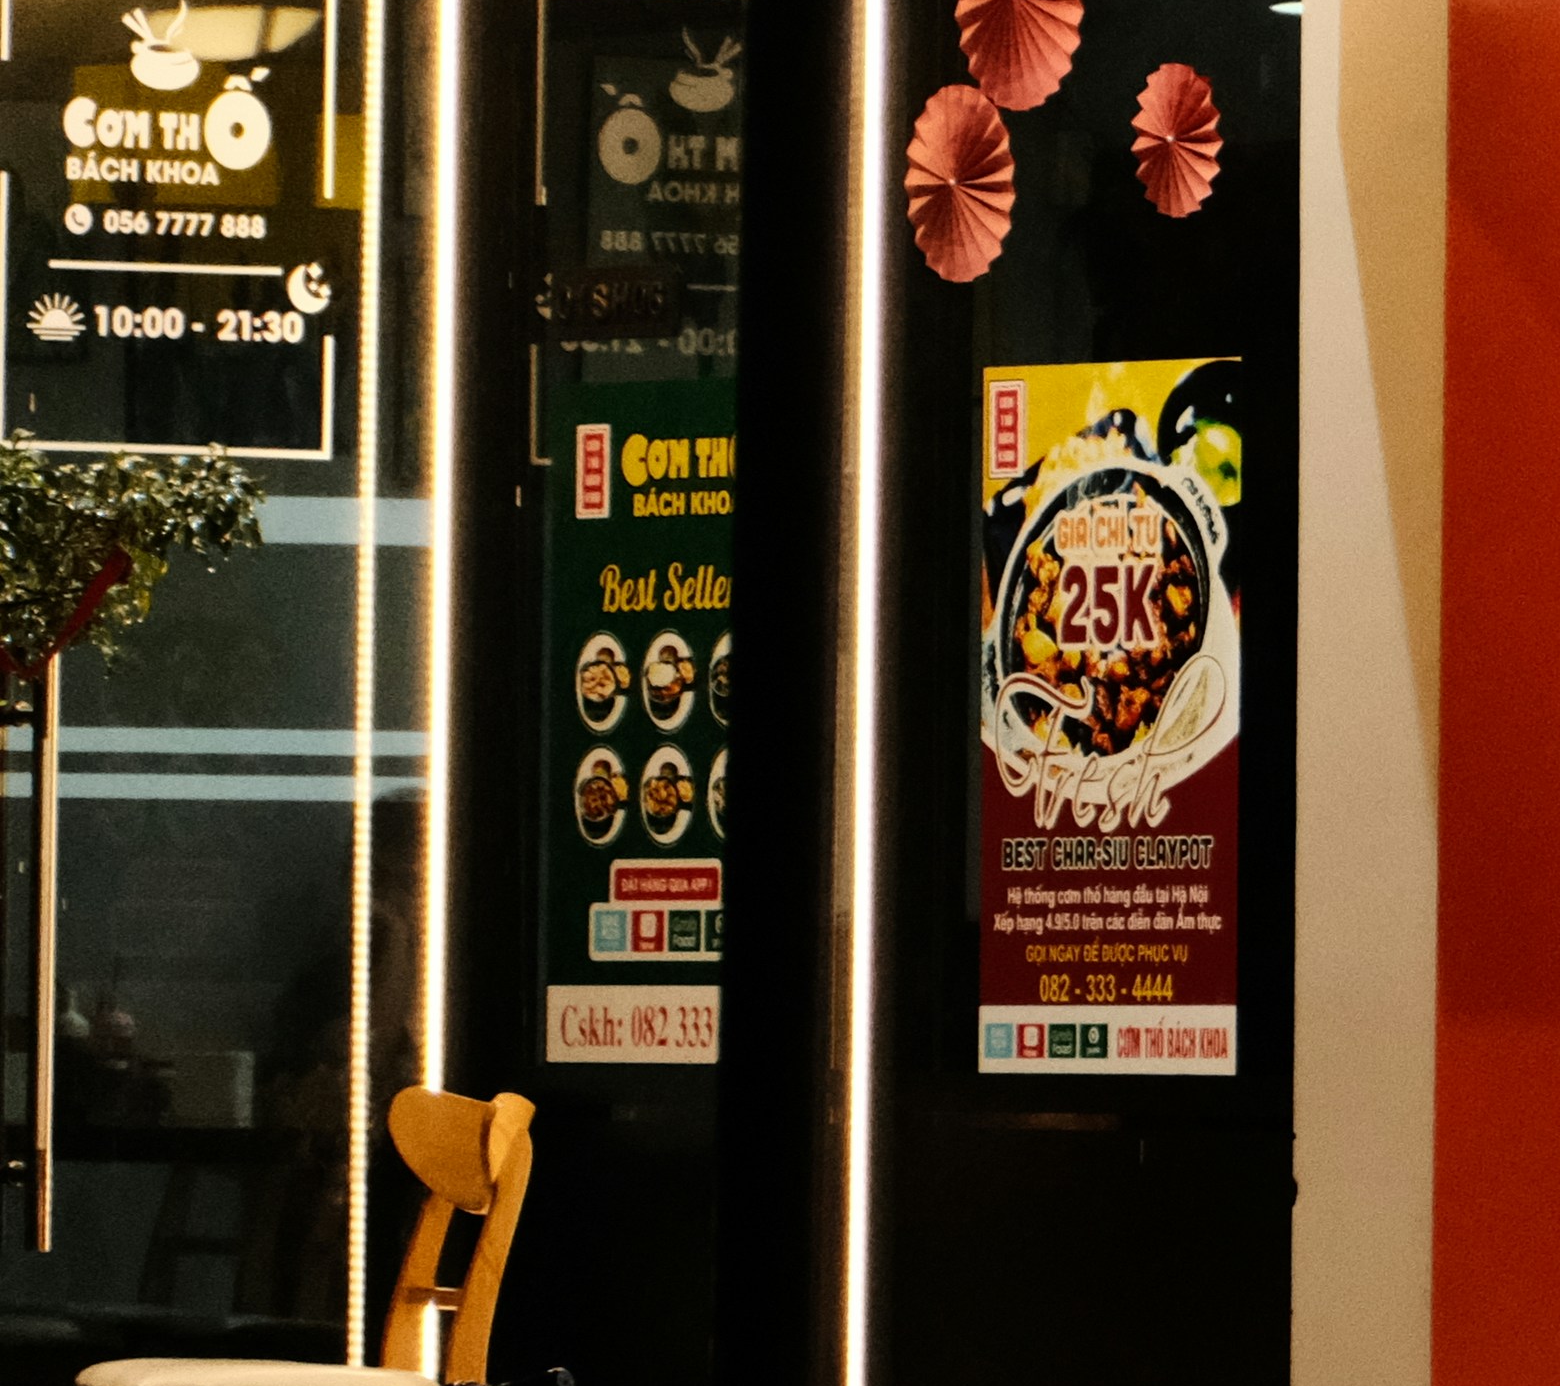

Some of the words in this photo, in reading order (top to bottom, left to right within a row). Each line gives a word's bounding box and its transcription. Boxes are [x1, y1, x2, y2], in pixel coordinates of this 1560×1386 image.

[63, 96, 151, 149] CƠM
[159, 67, 272, 171] THỐ
[66, 151, 139, 183] BÁCH
[146, 160, 220, 186] KHOA
[103, 209, 150, 235] 056
[156, 210, 215, 236] 7777
[220, 214, 267, 240] 888
[94, 305, 185, 340] 10:00
[216, 308, 306, 344] 21:30
[695, 434, 736, 480] TH
[632, 487, 686, 518] BÁCH
[690, 489, 734, 516] KHO
[600, 563, 659, 613] Best
[663, 562, 733, 612] Selle
[1060, 564, 1157, 646] 25K
[1002, 837, 1049, 871] BEST
[1052, 835, 1130, 871] CHAR-SIU
[1133, 834, 1214, 870] CLAYPOT
[1049, 944, 1081, 963] NGAY
[1039, 974, 1071, 1002] 082
[1086, 974, 1117, 1002] 333
[1132, 974, 1174, 1002] 4444
[560, 1004, 624, 1048] Cskh:
[630, 1005, 669, 1048] 082
[675, 1005, 714, 1048] 333
